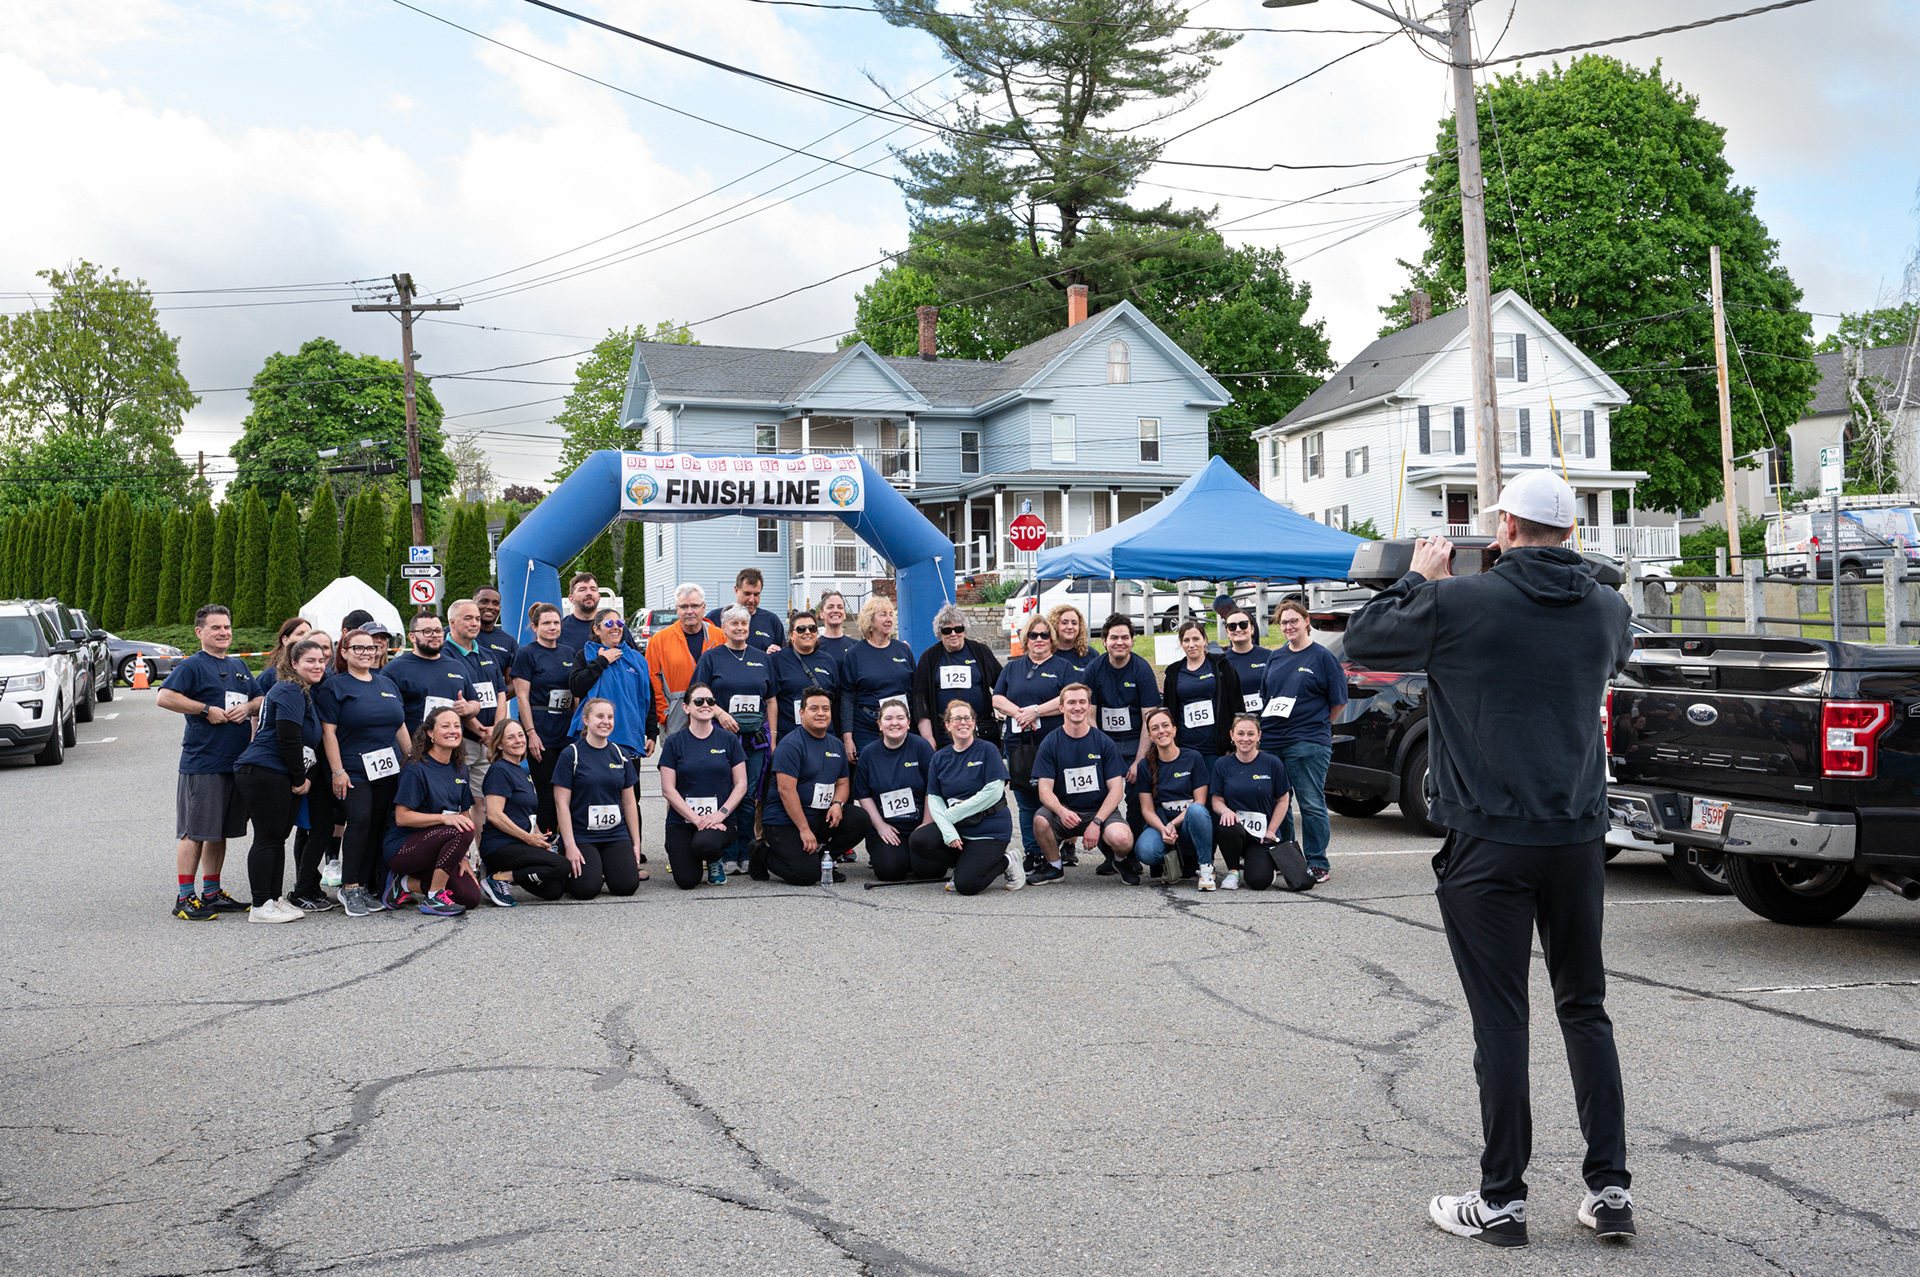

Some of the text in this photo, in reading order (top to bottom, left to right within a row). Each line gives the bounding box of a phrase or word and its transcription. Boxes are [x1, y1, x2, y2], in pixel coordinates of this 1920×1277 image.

[1821, 451, 1827, 465] 2
[666, 478, 755, 504] FINISH
[762, 480, 820, 504] LINE
[1010, 526, 1046, 540] STOP
[411, 548, 431, 562] PARKING
[946, 672, 966, 682] 125
[735, 703, 755, 712] 153
[1244, 700, 1258, 708] 46
[1270, 702, 1289, 712] 157
[1188, 708, 1209, 722] 155
[1691, 708, 1710, 720] Ford
[1106, 716, 1126, 726] 158
[370, 757, 394, 772] 126
[1070, 775, 1093, 786] 134
[818, 792, 832, 802] 145
[888, 796, 910, 810] 129
[594, 814, 616, 825] 148
[1240, 818, 1262, 832] 140
